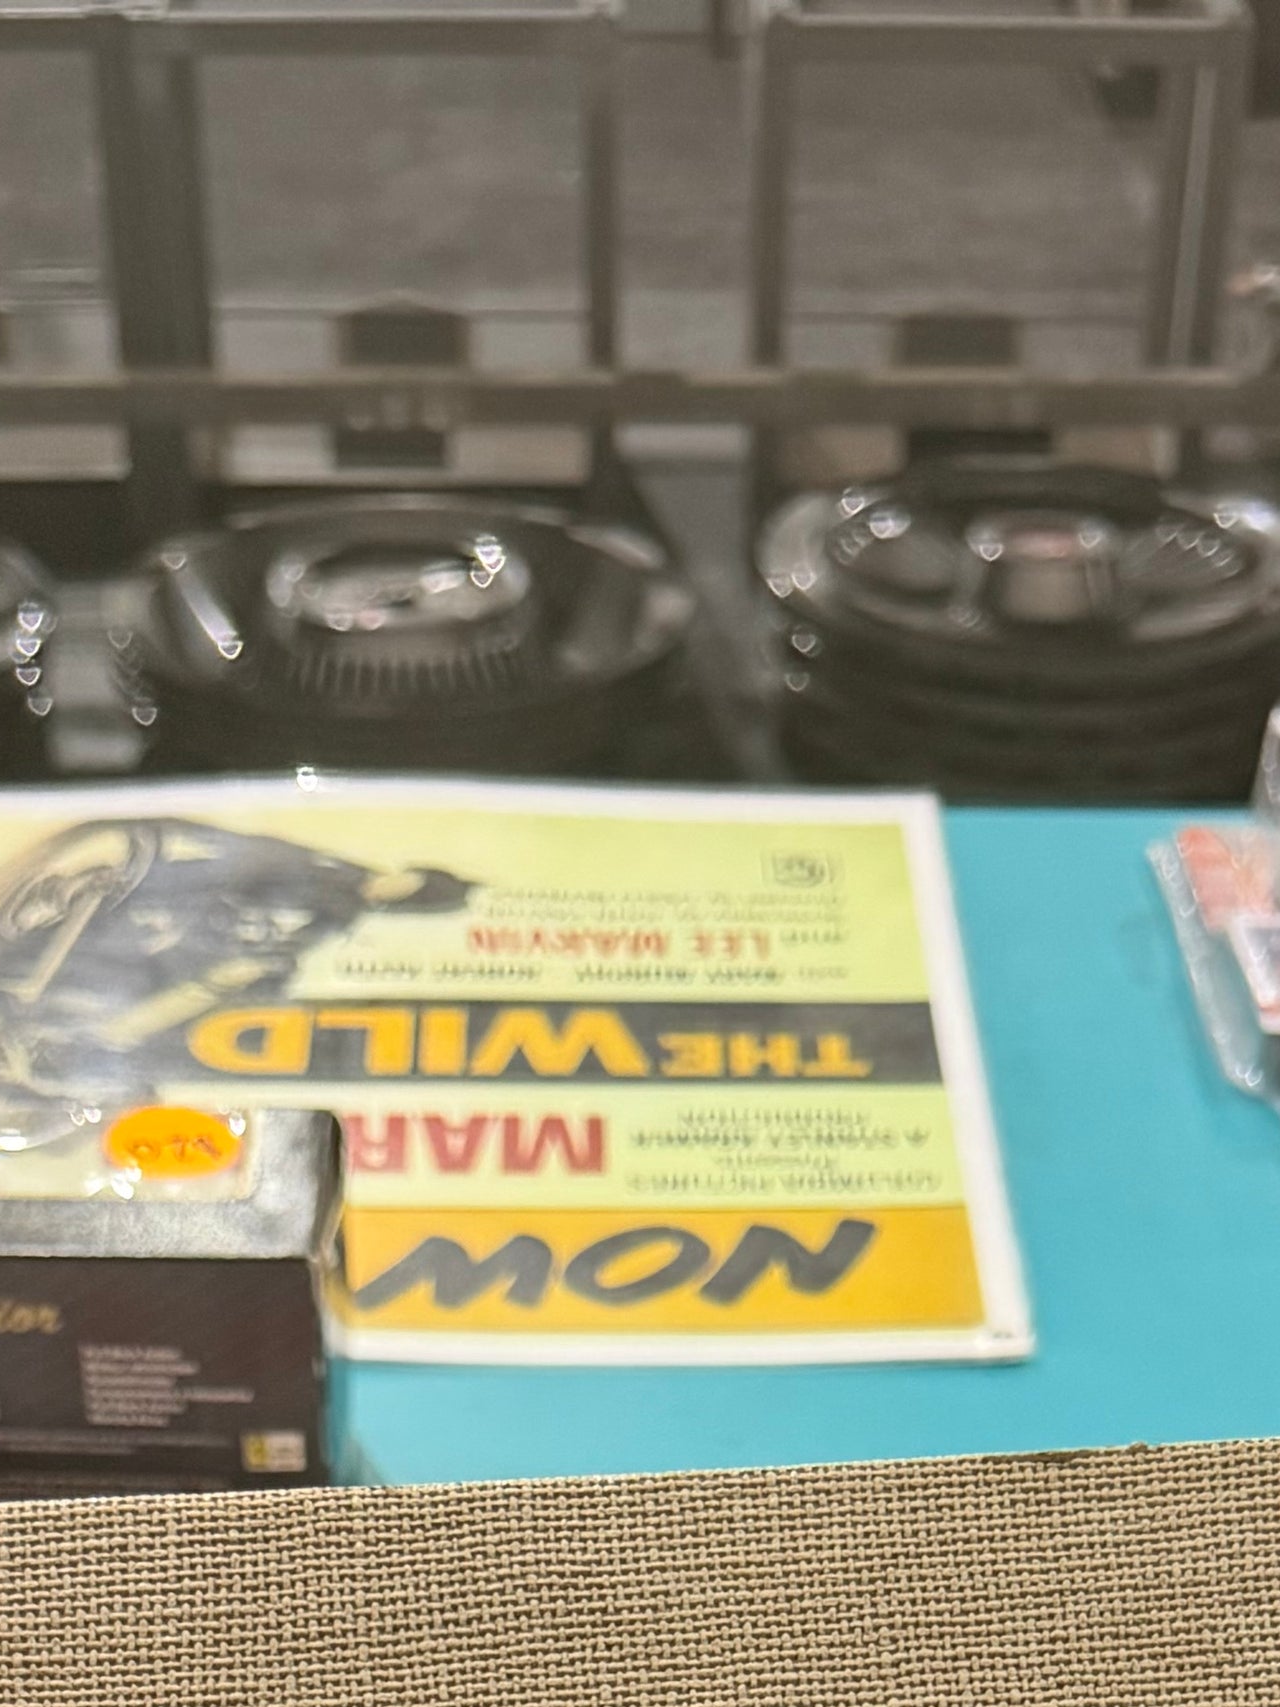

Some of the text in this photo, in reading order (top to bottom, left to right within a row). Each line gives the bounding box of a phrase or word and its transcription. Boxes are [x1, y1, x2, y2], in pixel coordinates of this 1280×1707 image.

[187, 1006, 651, 1078] WILD
[661, 1032, 873, 1078] THE
[354, 1216, 879, 1309] NOW
